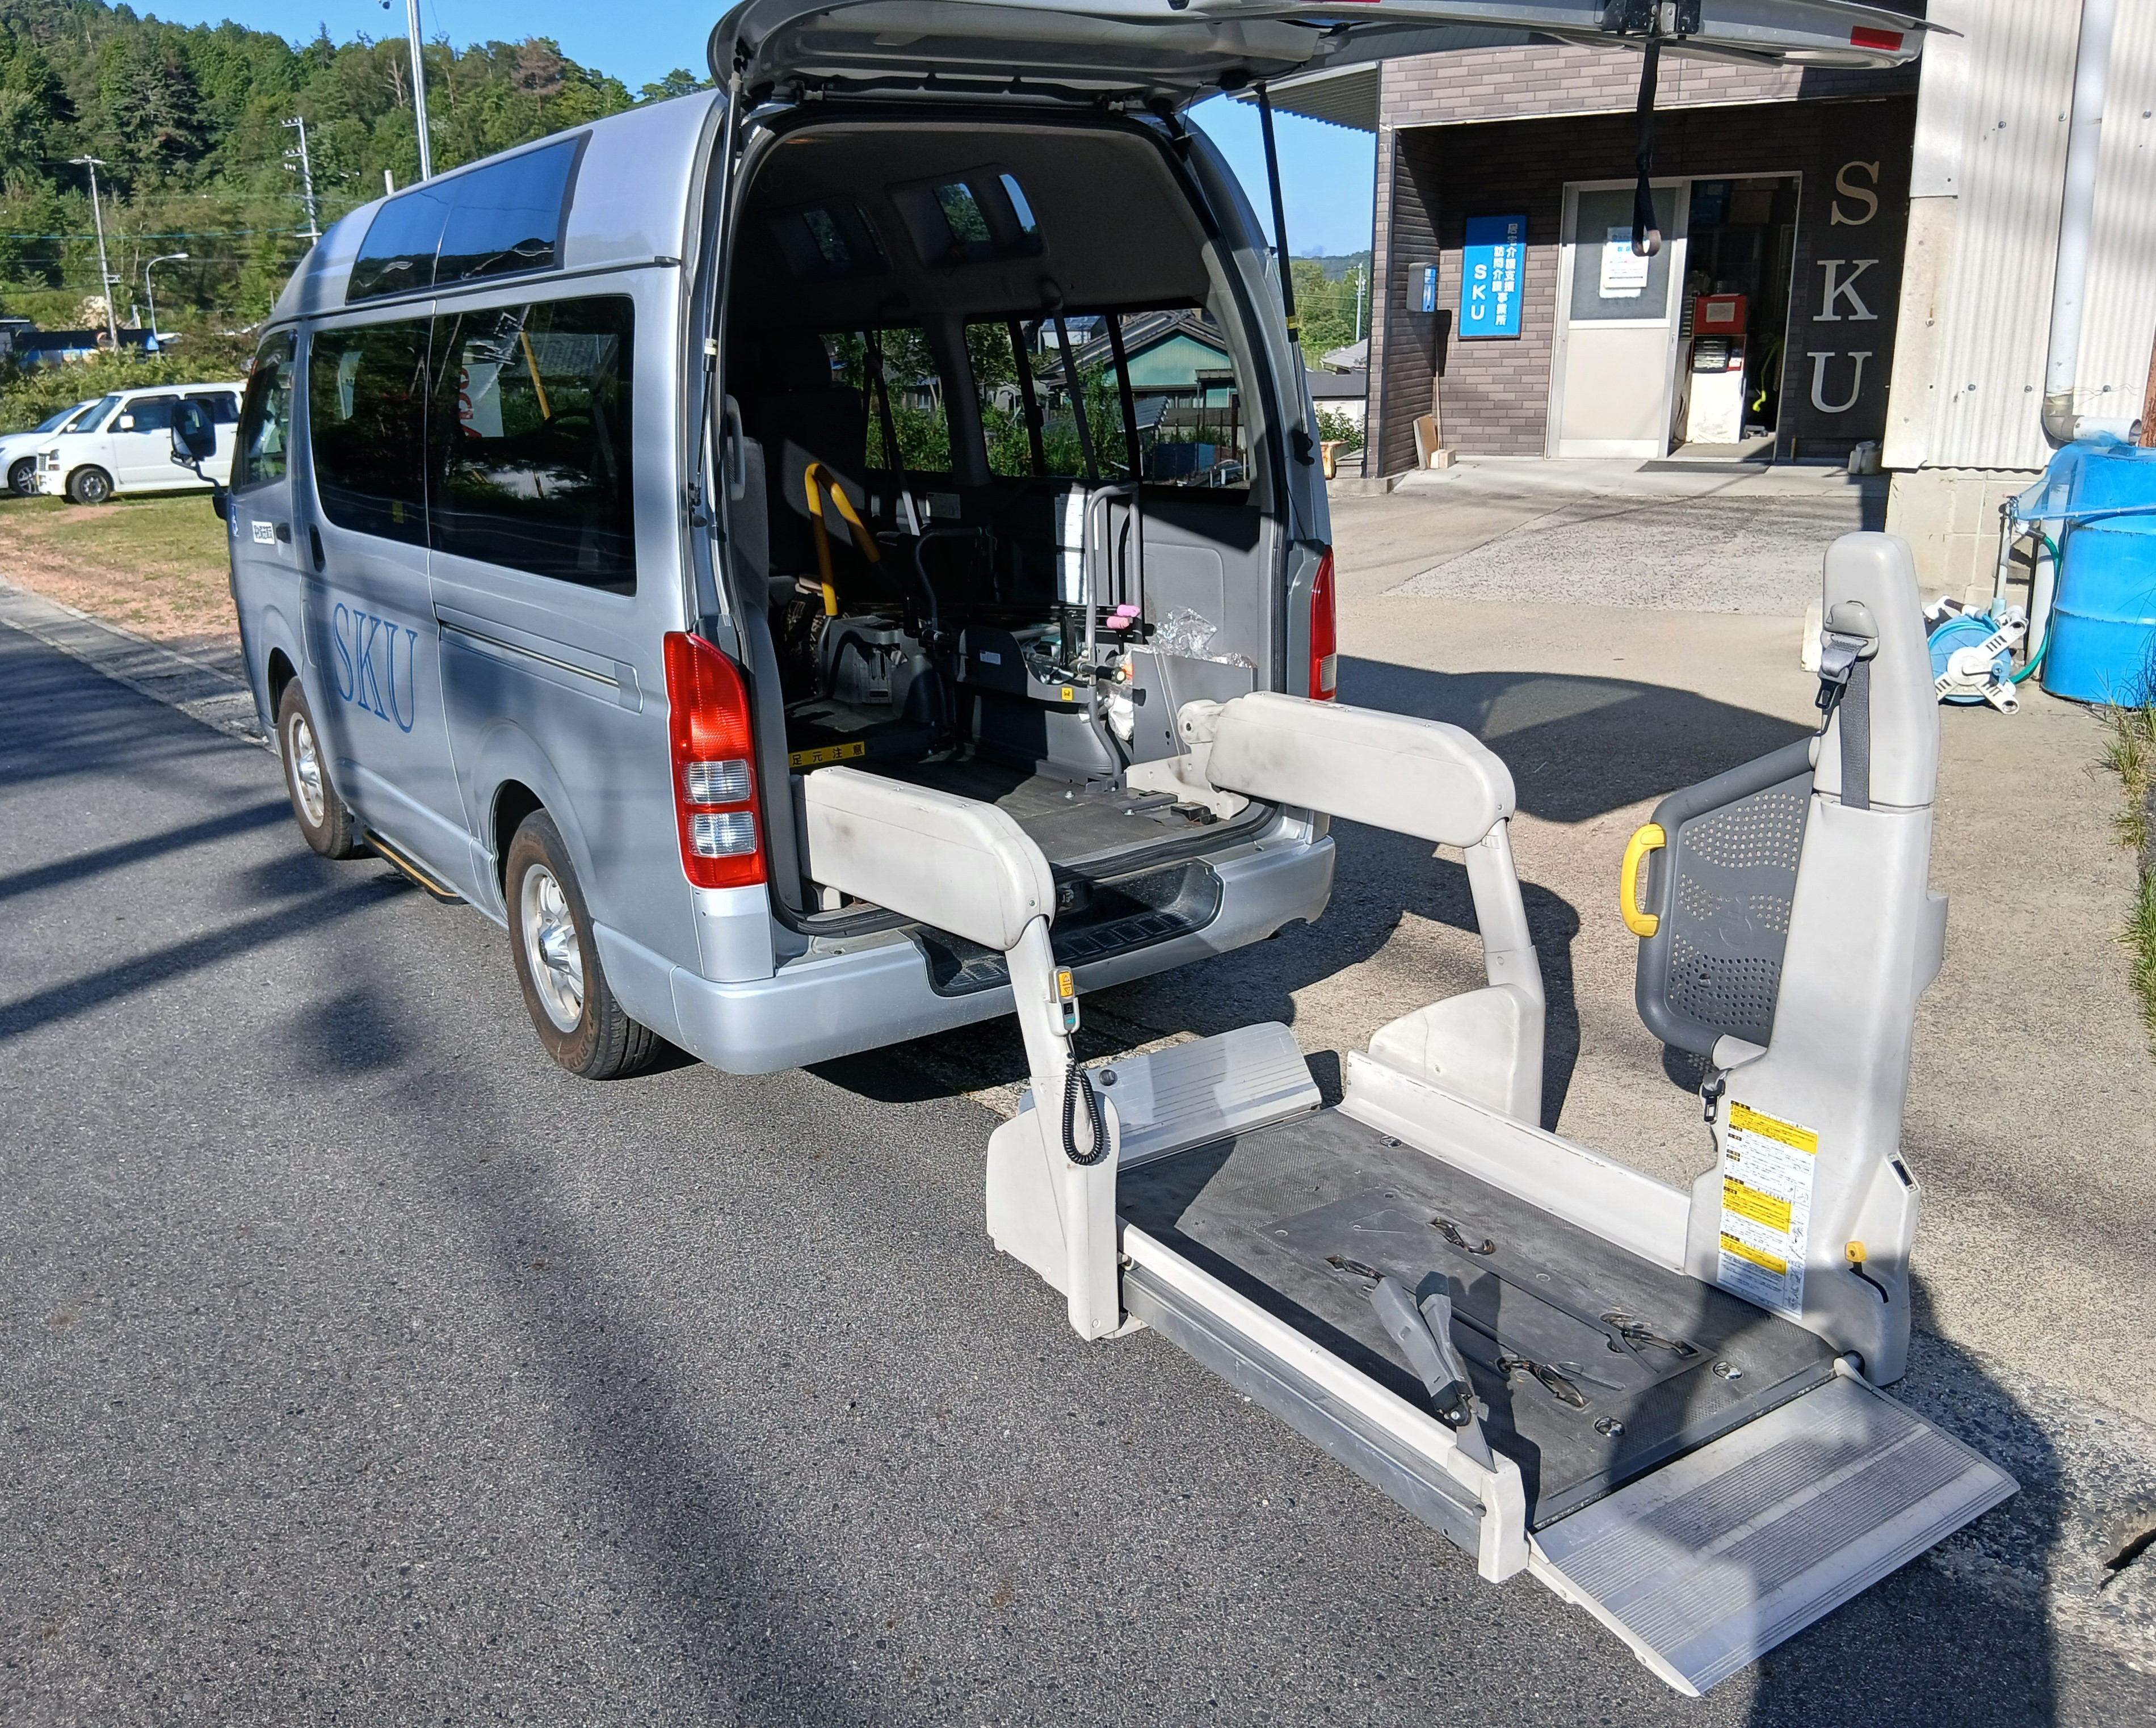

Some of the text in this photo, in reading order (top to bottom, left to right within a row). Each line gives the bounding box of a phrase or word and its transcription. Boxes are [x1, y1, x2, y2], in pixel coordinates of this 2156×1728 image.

[1491, 246, 1504, 292] 訪問介護
[1504, 223, 1518, 292] 居宅介護支援
[1471, 264, 1487, 320] SKU
[1495, 293, 1508, 326] 事業所
[1806, 160, 1880, 413] SKU
[333, 602, 418, 733] SKU
[792, 744, 863, 766] 足元注意
